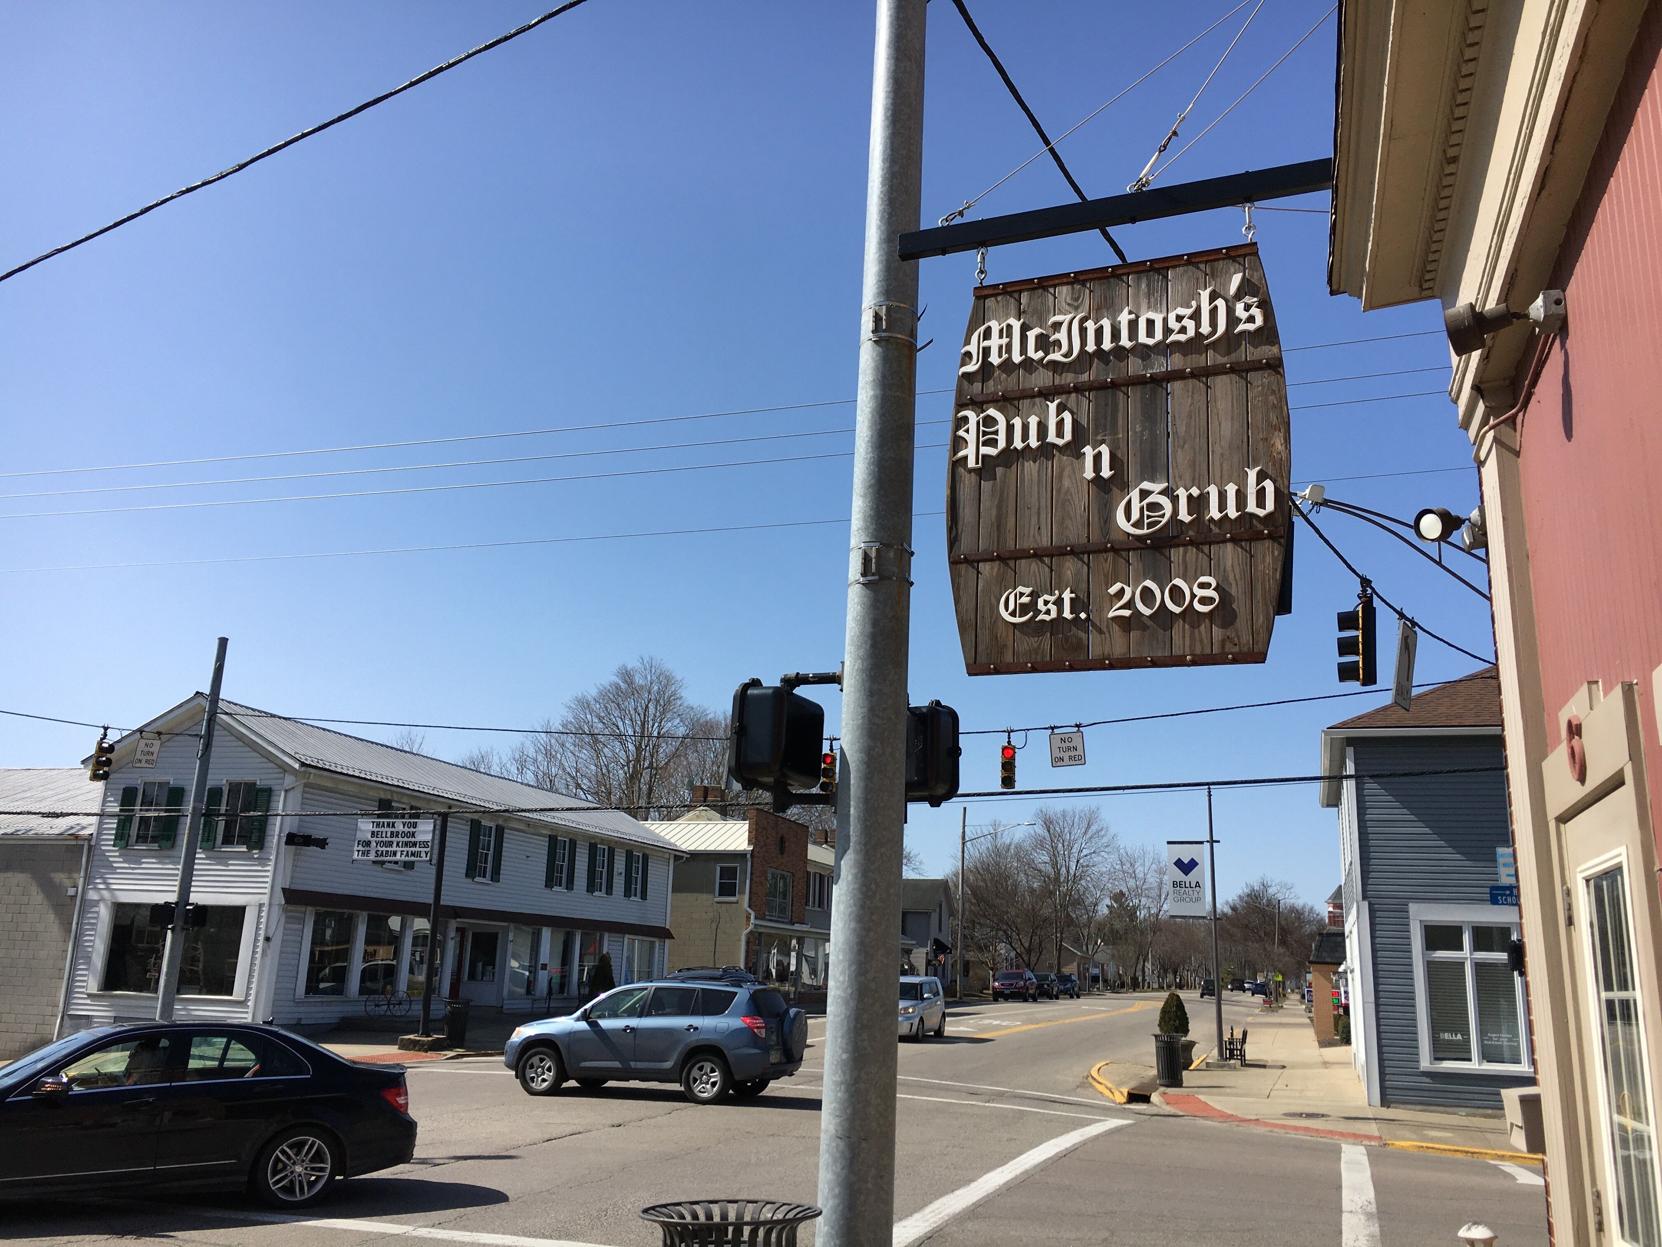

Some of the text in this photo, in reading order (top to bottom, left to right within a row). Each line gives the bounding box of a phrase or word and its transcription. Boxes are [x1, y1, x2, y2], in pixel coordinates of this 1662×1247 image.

[958, 273, 1264, 376] McIntosh's
[953, 399, 1073, 469] Pub
[1082, 443, 1115, 480] n
[1116, 466, 1276, 535] Grub
[998, 575, 1221, 624] Est. 2008
[1060, 736, 1073, 744] NO
[1057, 745, 1078, 753] TURN
[1068, 754, 1083, 762] RED
[371, 821, 418, 829] THANK YOU
[370, 831, 417, 839] BELLBROOK
[395, 841, 430, 849] KINDNESS
[356, 850, 430, 859] THE SABIN FAMILY
[1172, 880, 1201, 888] BELLA
[1172, 889, 1201, 897] REALTY
